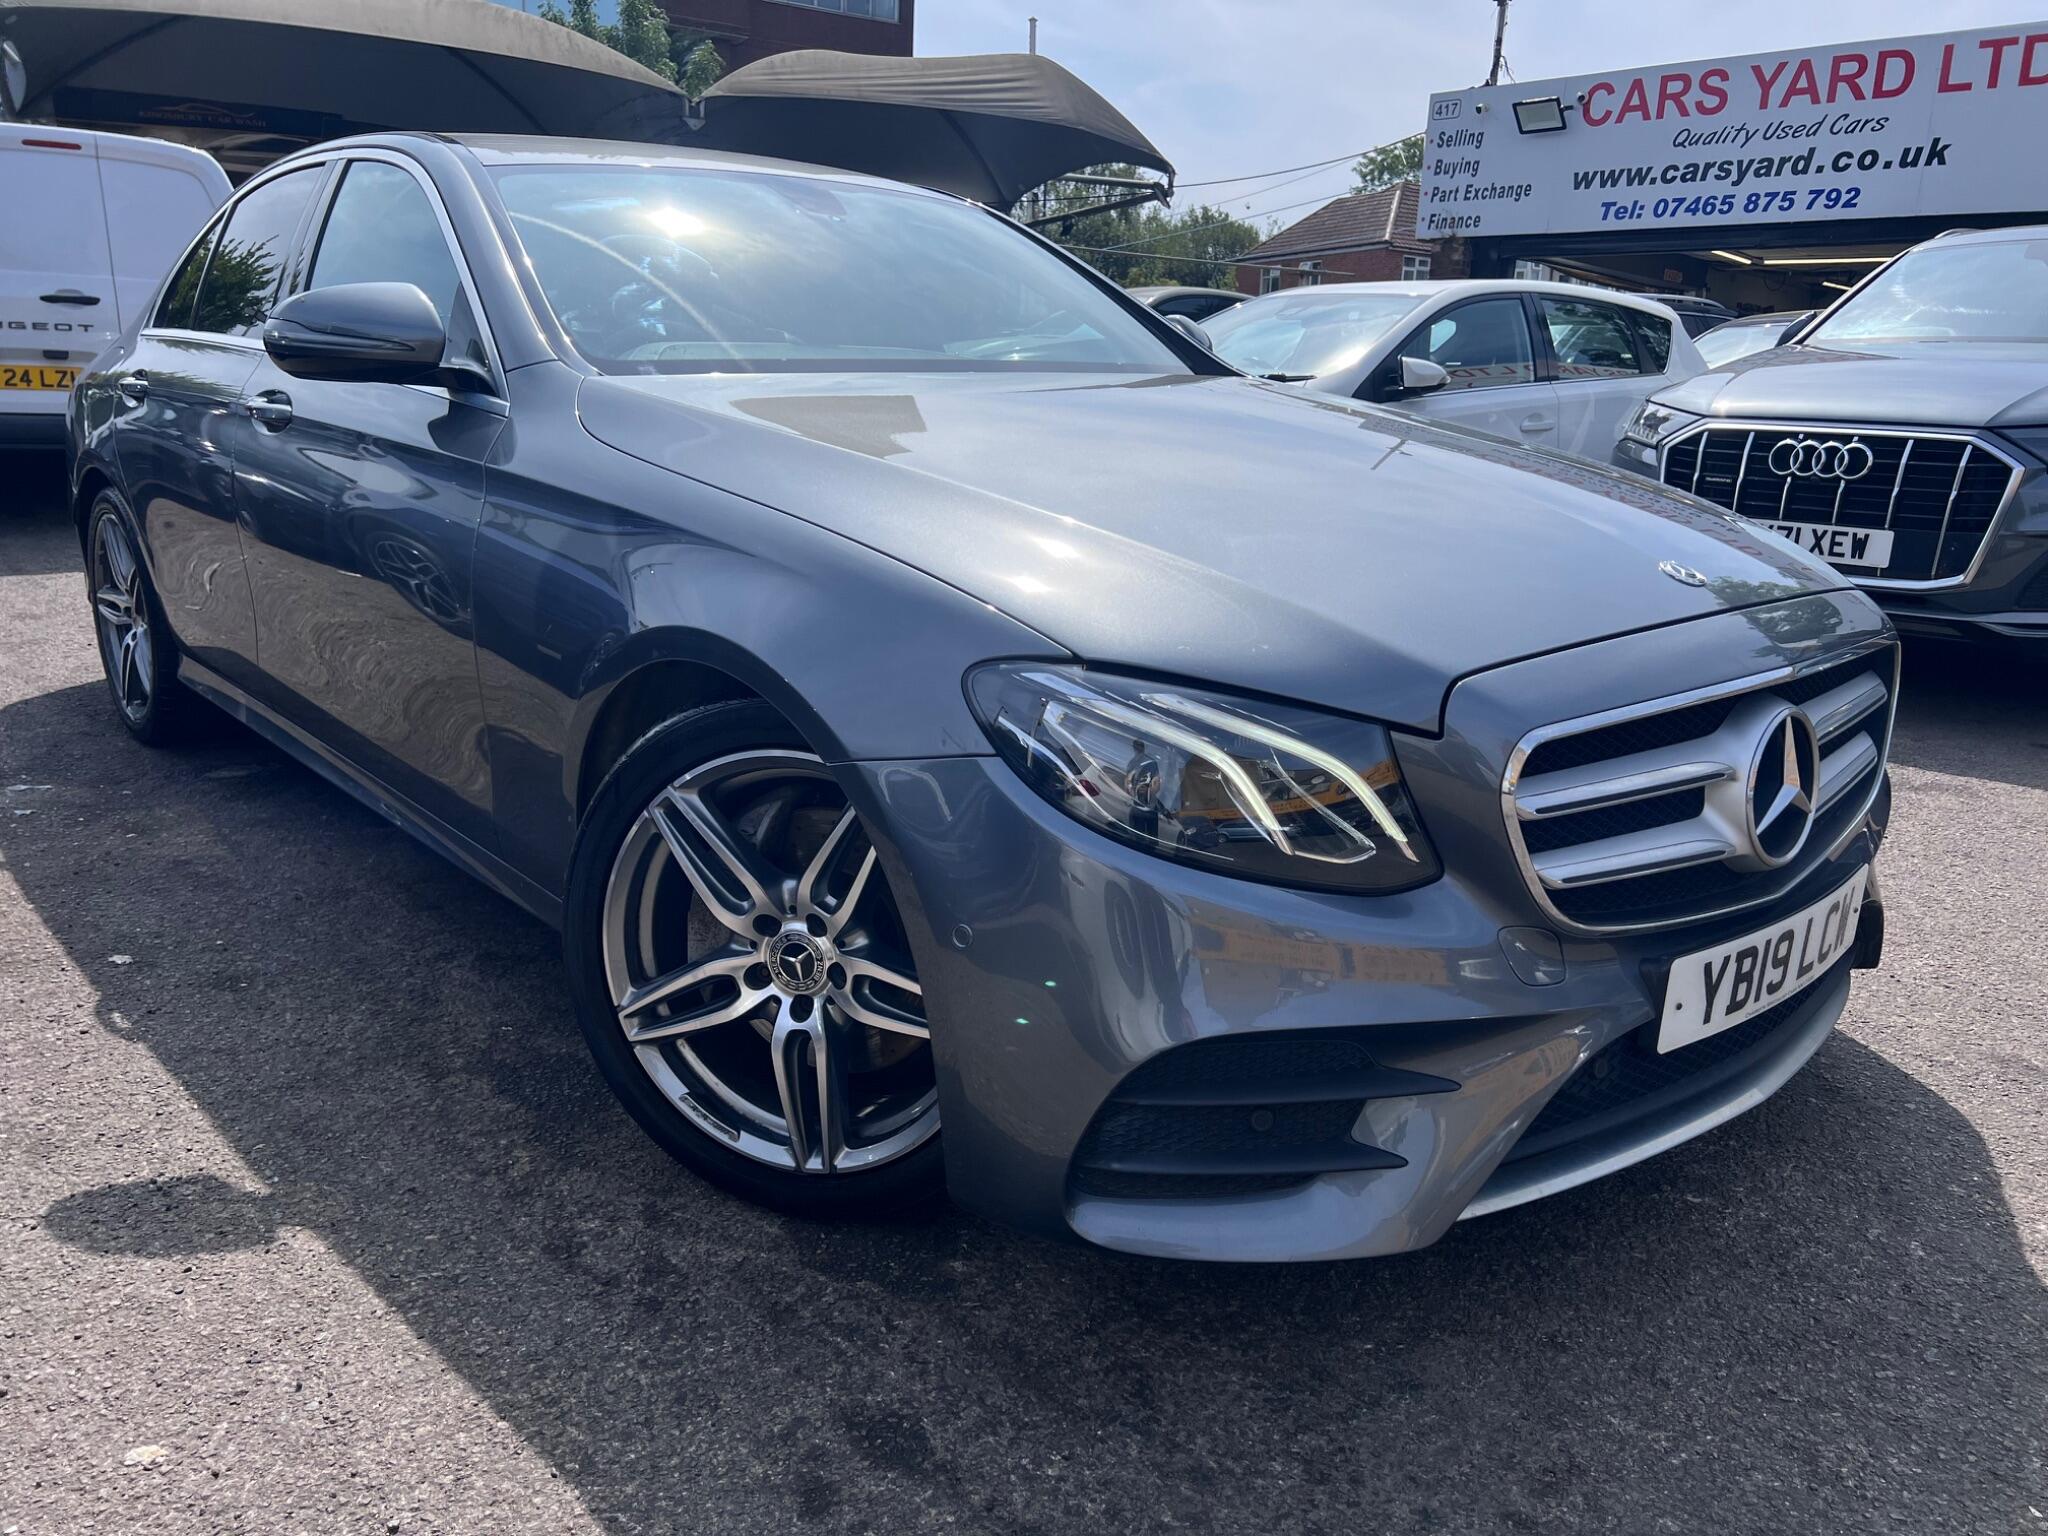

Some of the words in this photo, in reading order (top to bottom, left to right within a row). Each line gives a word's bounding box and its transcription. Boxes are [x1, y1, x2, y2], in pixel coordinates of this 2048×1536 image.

[1582, 68, 1730, 127] CARS
[1751, 49, 1916, 110] YARD
[1937, 33, 2048, 93] LTD
[1435, 102, 1459, 117] 417
[1437, 129, 1485, 149] Selling
[1672, 122, 1760, 148] Quality
[1762, 114, 1829, 141] Used
[1829, 113, 1890, 136] Cars
[1433, 157, 1480, 179] Buying
[1573, 137, 1952, 190] www.carsyard.co.uk
[1430, 186, 1459, 203] Part
[1464, 183, 1532, 202] Exchange
[1601, 200, 1646, 221] Tel:
[1653, 194, 1736, 218] 07465
[1743, 190, 1797, 213] 875
[1805, 187, 1861, 210] 792
[1427, 213, 1481, 230] Finance
[0, 321, 94, 332] GEOT
[3, 368, 33, 387] 24
[1768, 524, 1802, 545] 71
[1809, 528, 1870, 560] XEW
[1703, 928, 1795, 1026] YB19
[1796, 886, 1855, 981] LCW
